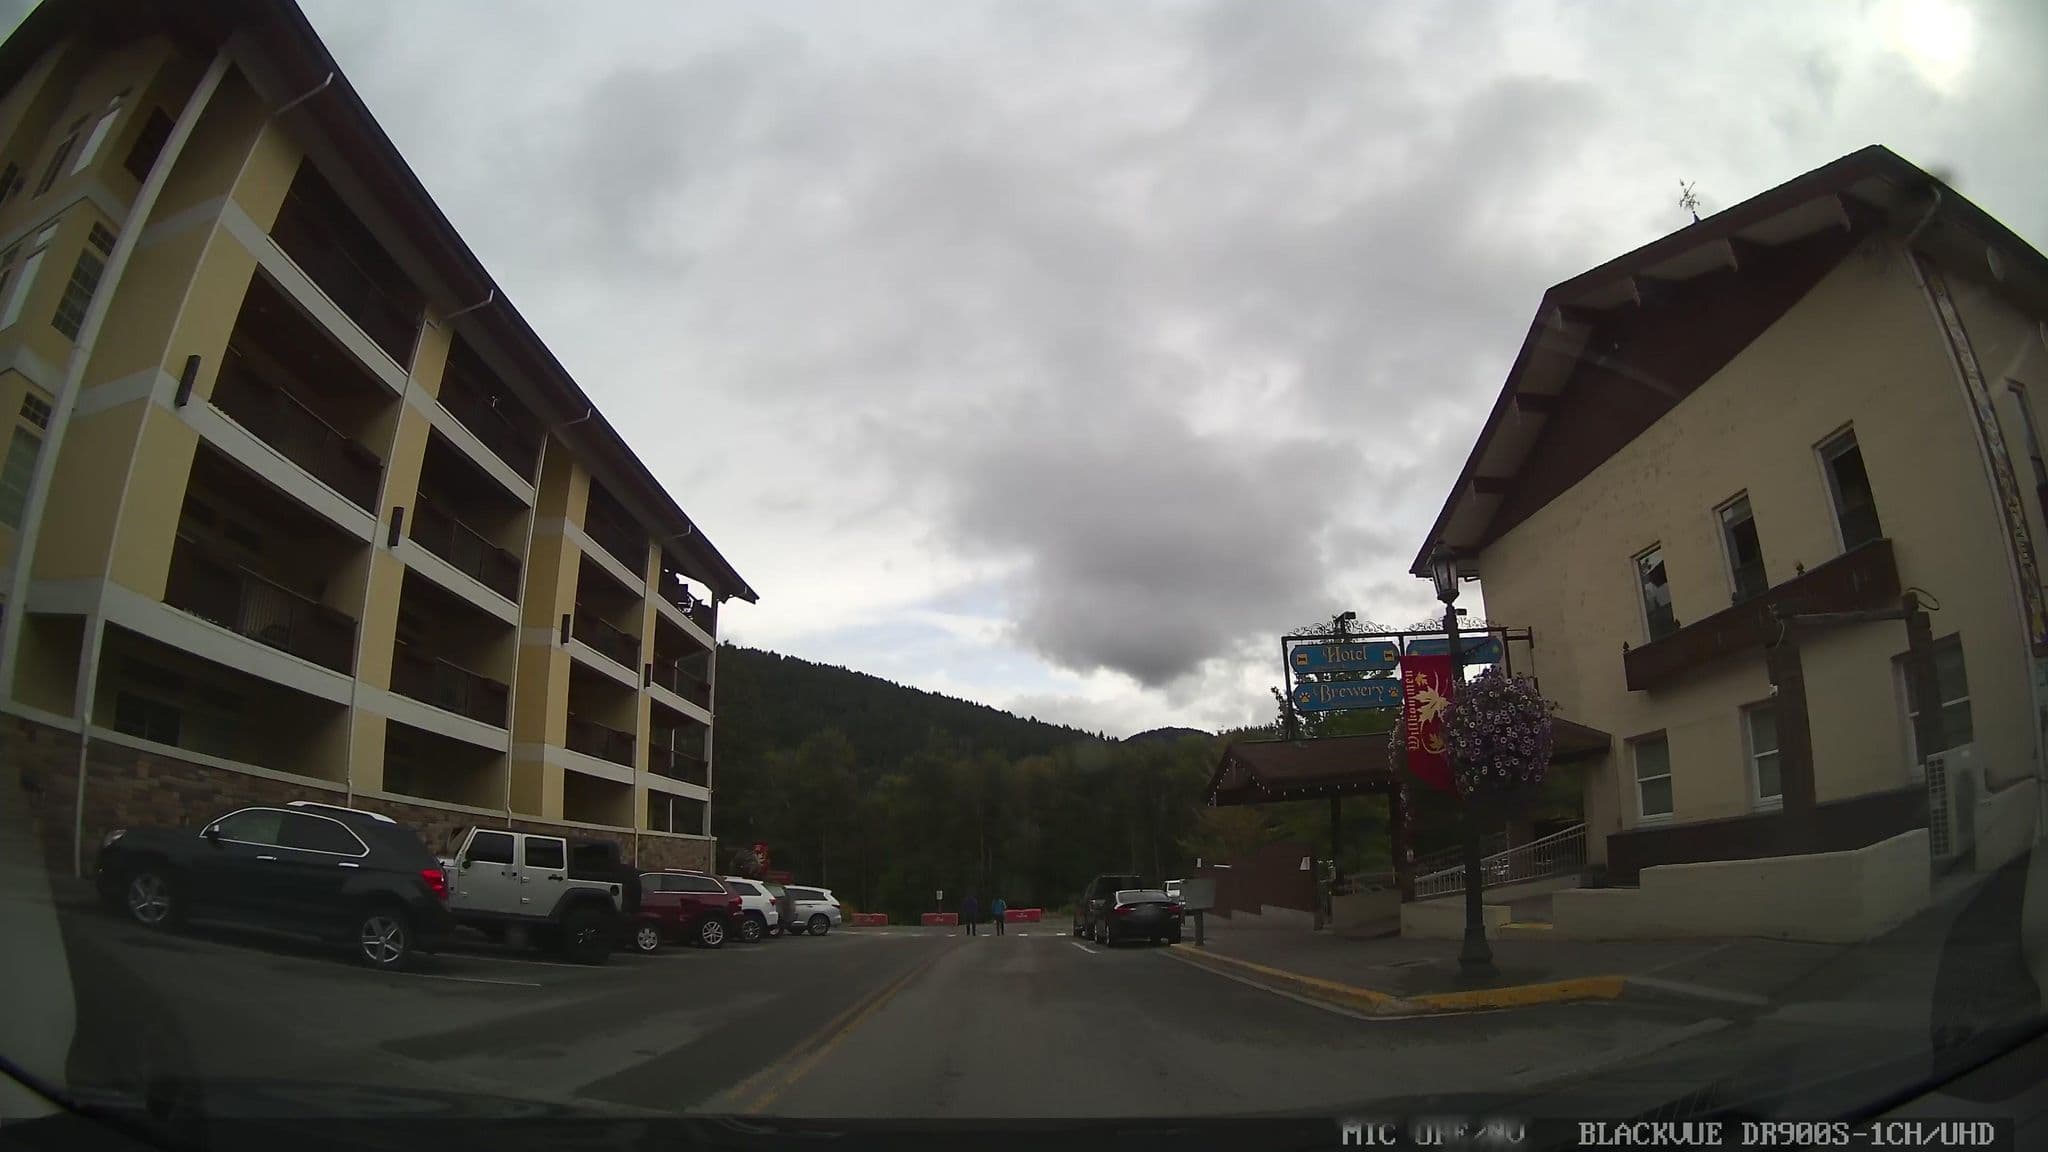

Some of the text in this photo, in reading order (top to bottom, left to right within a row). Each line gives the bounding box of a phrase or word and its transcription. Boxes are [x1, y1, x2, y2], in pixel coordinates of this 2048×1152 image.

[1323, 645, 1368, 663] Hotel
[1313, 684, 1384, 704] Brewery
[1405, 670, 1420, 751] Willkommen
